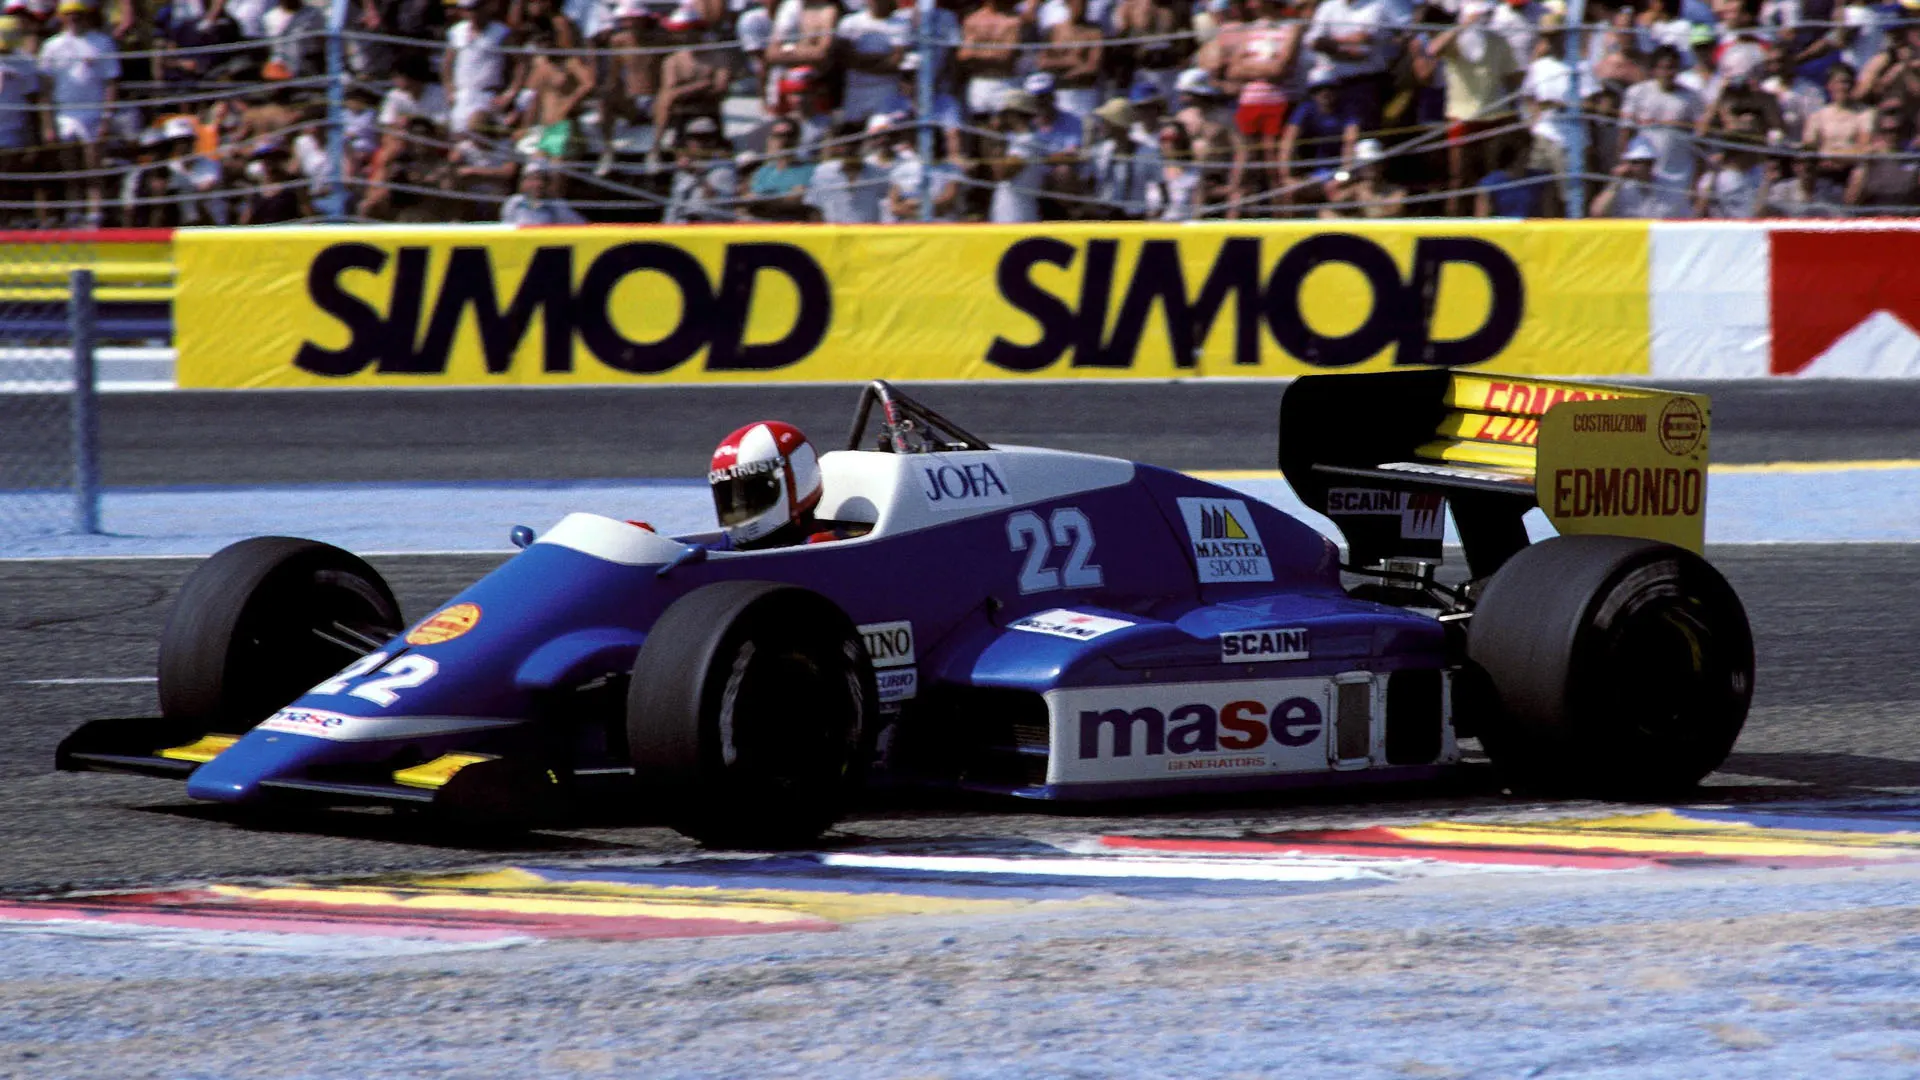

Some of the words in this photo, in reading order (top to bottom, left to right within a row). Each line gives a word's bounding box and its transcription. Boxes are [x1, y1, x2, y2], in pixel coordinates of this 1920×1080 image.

[291, 241, 833, 377] SIMOD
[984, 232, 1525, 372] SIMOD
[1573, 413, 1647, 433] COSTRUZIONI
[924, 462, 1010, 501] JOFA
[1554, 467, 1701, 518] EDMONDO
[1328, 491, 1401, 511] SCAINI
[1005, 507, 1104, 595] 22
[1194, 542, 1265, 558] MASTER
[1209, 559, 1260, 577] SPORT
[863, 628, 910, 658] INO
[1222, 631, 1308, 656] SCAINI
[308, 651, 440, 708] 22
[1078, 697, 1323, 760] mase
[1167, 756, 1266, 772] GENERATORS
